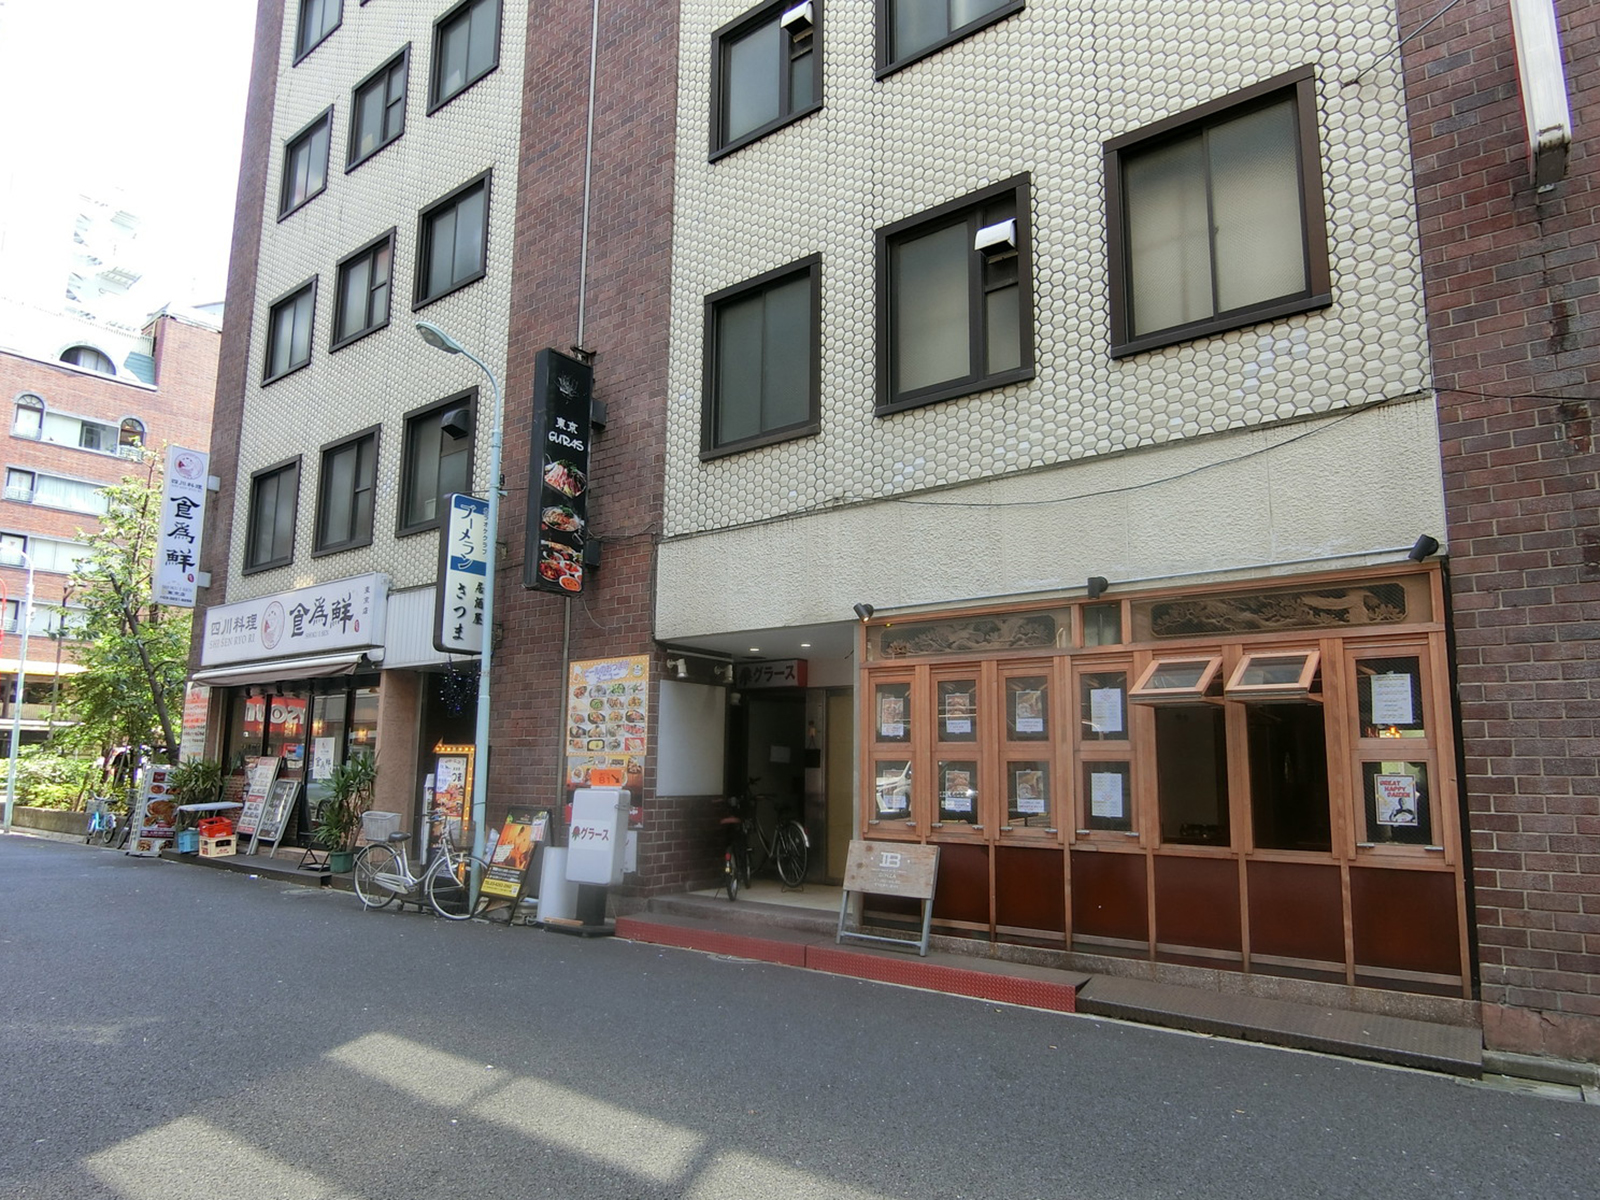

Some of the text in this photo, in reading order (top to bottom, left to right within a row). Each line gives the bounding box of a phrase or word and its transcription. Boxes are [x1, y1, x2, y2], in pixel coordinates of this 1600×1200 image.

[556, 417, 578, 434] 東京
[548, 431, 584, 451] GURAS
[453, 583, 466, 640] さつま
[211, 614, 258, 635] 四川料理
[753, 665, 795, 683] グラース
[581, 827, 609, 841] グラース
